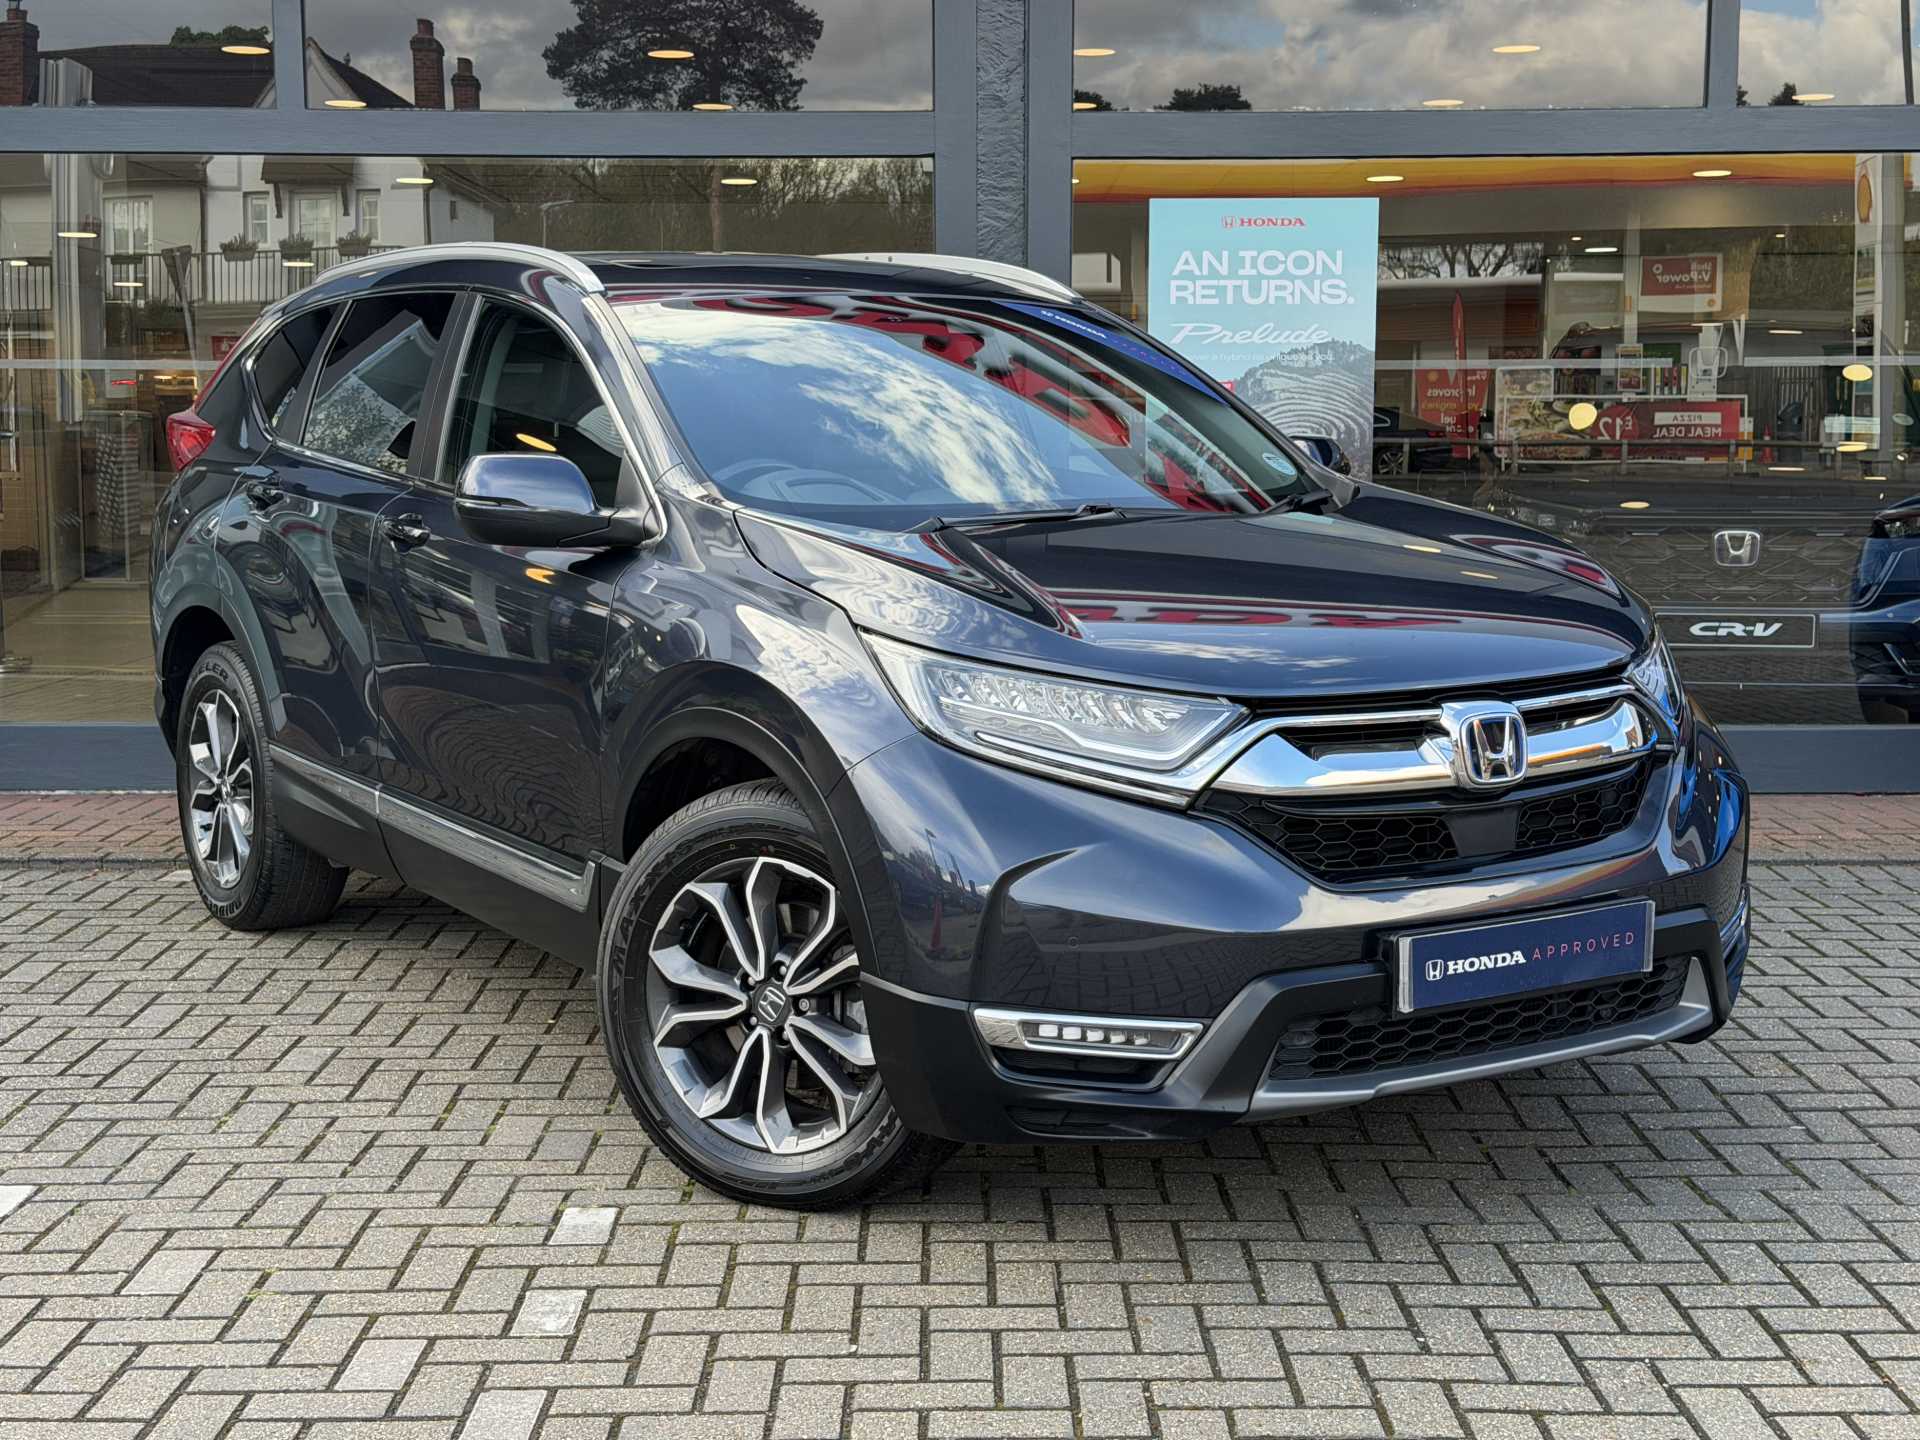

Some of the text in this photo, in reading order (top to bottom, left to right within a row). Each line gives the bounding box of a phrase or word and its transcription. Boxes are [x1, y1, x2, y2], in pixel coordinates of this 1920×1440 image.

[1239, 216, 1306, 227] HONDA
[1172, 250, 1343, 276] AN ICON
[1169, 279, 1355, 305] RETURNS.
[1169, 322, 1333, 345] Prelude
[1689, 621, 1783, 637] CR-V
[1446, 950, 1526, 976] HONDA
[1532, 931, 1635, 961] APPROVED
